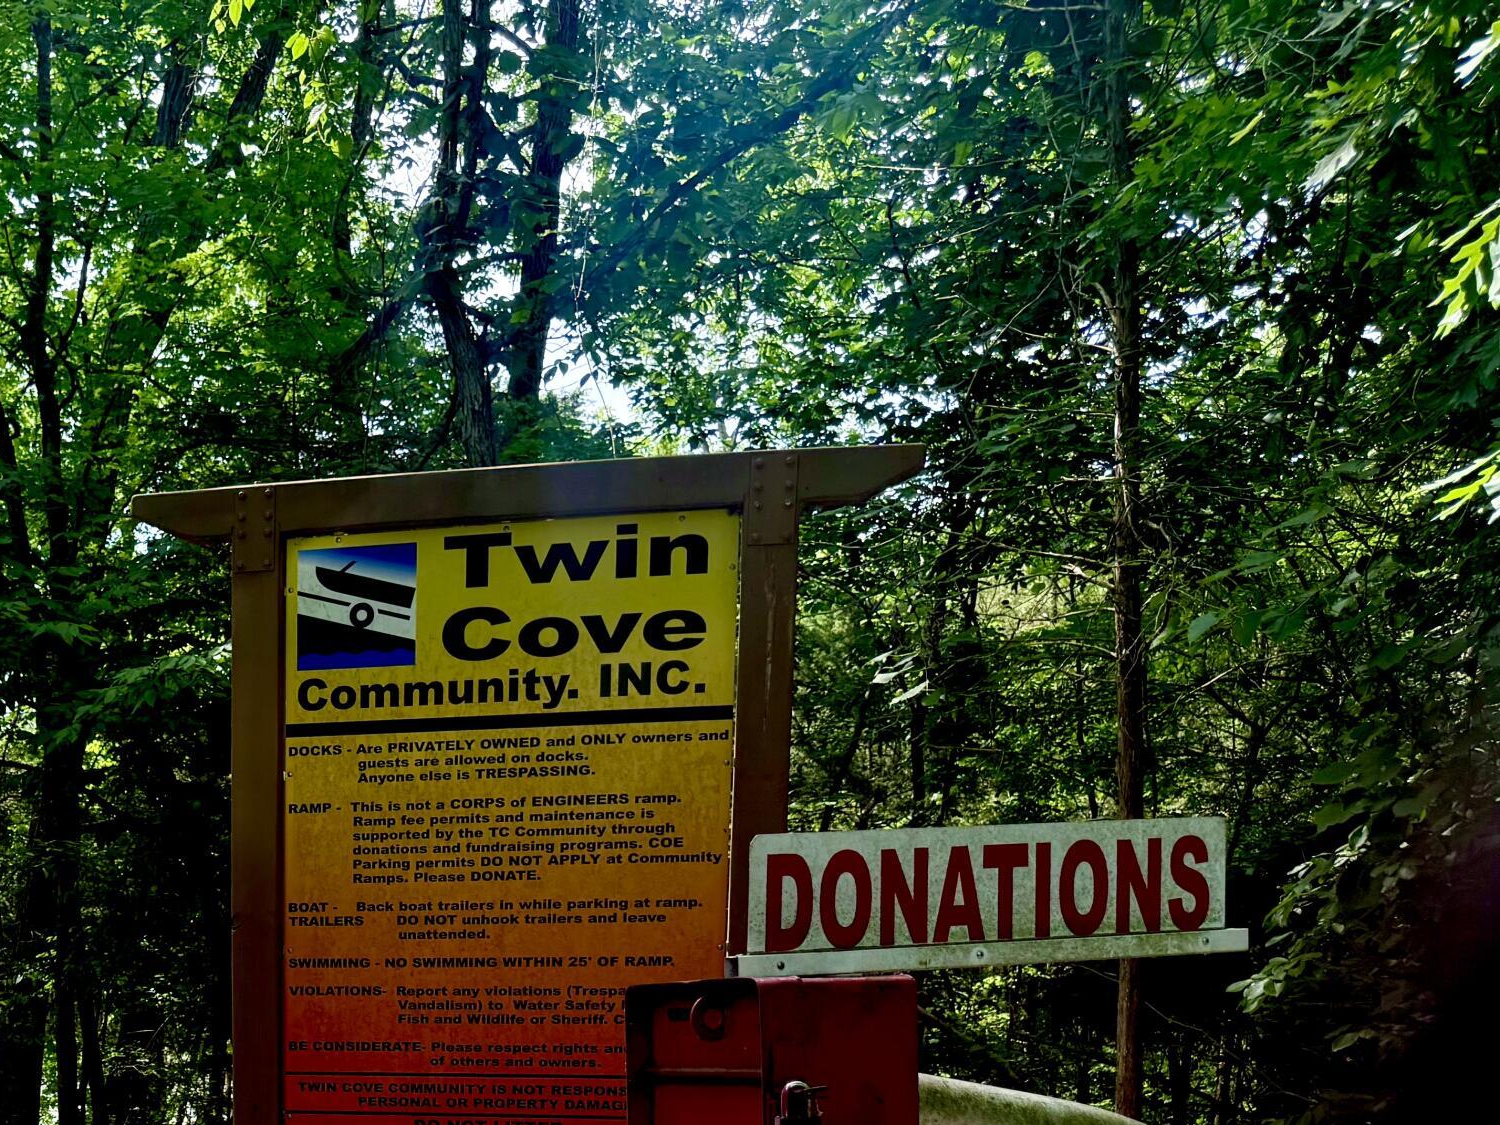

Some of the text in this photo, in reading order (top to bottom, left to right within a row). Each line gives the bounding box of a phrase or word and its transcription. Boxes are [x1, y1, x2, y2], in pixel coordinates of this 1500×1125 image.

[444, 523, 709, 588] Twin
[443, 607, 707, 661] Cove
[600, 660, 705, 697] INC.
[289, 745, 342, 756] DOCKS
[357, 744, 382, 754] Are
[388, 740, 474, 752] PRIVATELY
[480, 737, 540, 750] OWNED
[547, 736, 575, 746] and
[581, 734, 626, 745] ONLY
[632, 733, 692, 743] owners
[699, 730, 729, 741] and
[358, 751, 588, 771] guests are allowed on docks.
[358, 765, 595, 785] Anyone else is TRESPASSING.
[289, 804, 331, 813] RAMP
[351, 802, 382, 812] This
[389, 801, 399, 811] is
[406, 801, 430, 811] not
[451, 798, 504, 809] CORPS
[511, 797, 525, 807] of
[532, 794, 629, 807] ENGINEERS
[635, 794, 681, 806] ramp.
[354, 808, 654, 828] Ramp fee permits and maintenance is
[353, 823, 674, 842] supported by the TC Community through
[353, 837, 684, 855] donations and fundraising programs. COE
[353, 852, 722, 870] Parking permits DO NOT APPLY at Community
[353, 871, 540, 885] Ramps. Please DONATE.
[766, 834, 1210, 952] DONATIONS
[289, 903, 328, 912] BOAT
[357, 902, 393, 911] Back
[399, 902, 432, 910] boat
[438, 901, 494, 910] trailers
[500, 900, 513, 910] in
[519, 900, 562, 909] while
[567, 898, 628, 910] parking
[635, 899, 650, 907] at
[656, 899, 702, 908] ramp.
[289, 913, 666, 926] TRAILERS DO NOT unhook trailers and leave
[399, 930, 490, 939] unattended.
[289, 958, 370, 968] SWIMMING
[385, 958, 407, 967] NO
[413, 958, 497, 967] SWIMMING
[503, 957, 562, 967] WITHIN
[597, 957, 618, 967] OF
[625, 957, 674, 967] RAMP.
[397, 986, 448, 997] Report
[452, 988, 479, 997] any
[485, 986, 561, 996] violations
[567, 986, 627, 996] (Trespa
[398, 1000, 482, 1012] Vandalism)
[488, 1001, 503, 1010] to
[513, 1000, 559, 1010] Water
[565, 1000, 615, 1012] Safety
[398, 1015, 428, 1024] Fish
[434, 1015, 461, 1024] and
[467, 1015, 524, 1024] Wildlife
[530, 1016, 546, 1024] or
[551, 1015, 607, 1025] Sheriff.
[289, 1042, 308, 1051] BE
[432, 1042, 481, 1052] Please
[489, 1043, 547, 1054] respect
[553, 1043, 598, 1055] rights
[430, 1057, 601, 1067] of others and owners.
[299, 1082, 626, 1096] TWIN COVE COMMUNITY IS NOT RESPONS
[359, 1097, 440, 1107] PERSONAL
[446, 1098, 468, 1107] OR
[474, 1099, 557, 1109] PROPERTY
